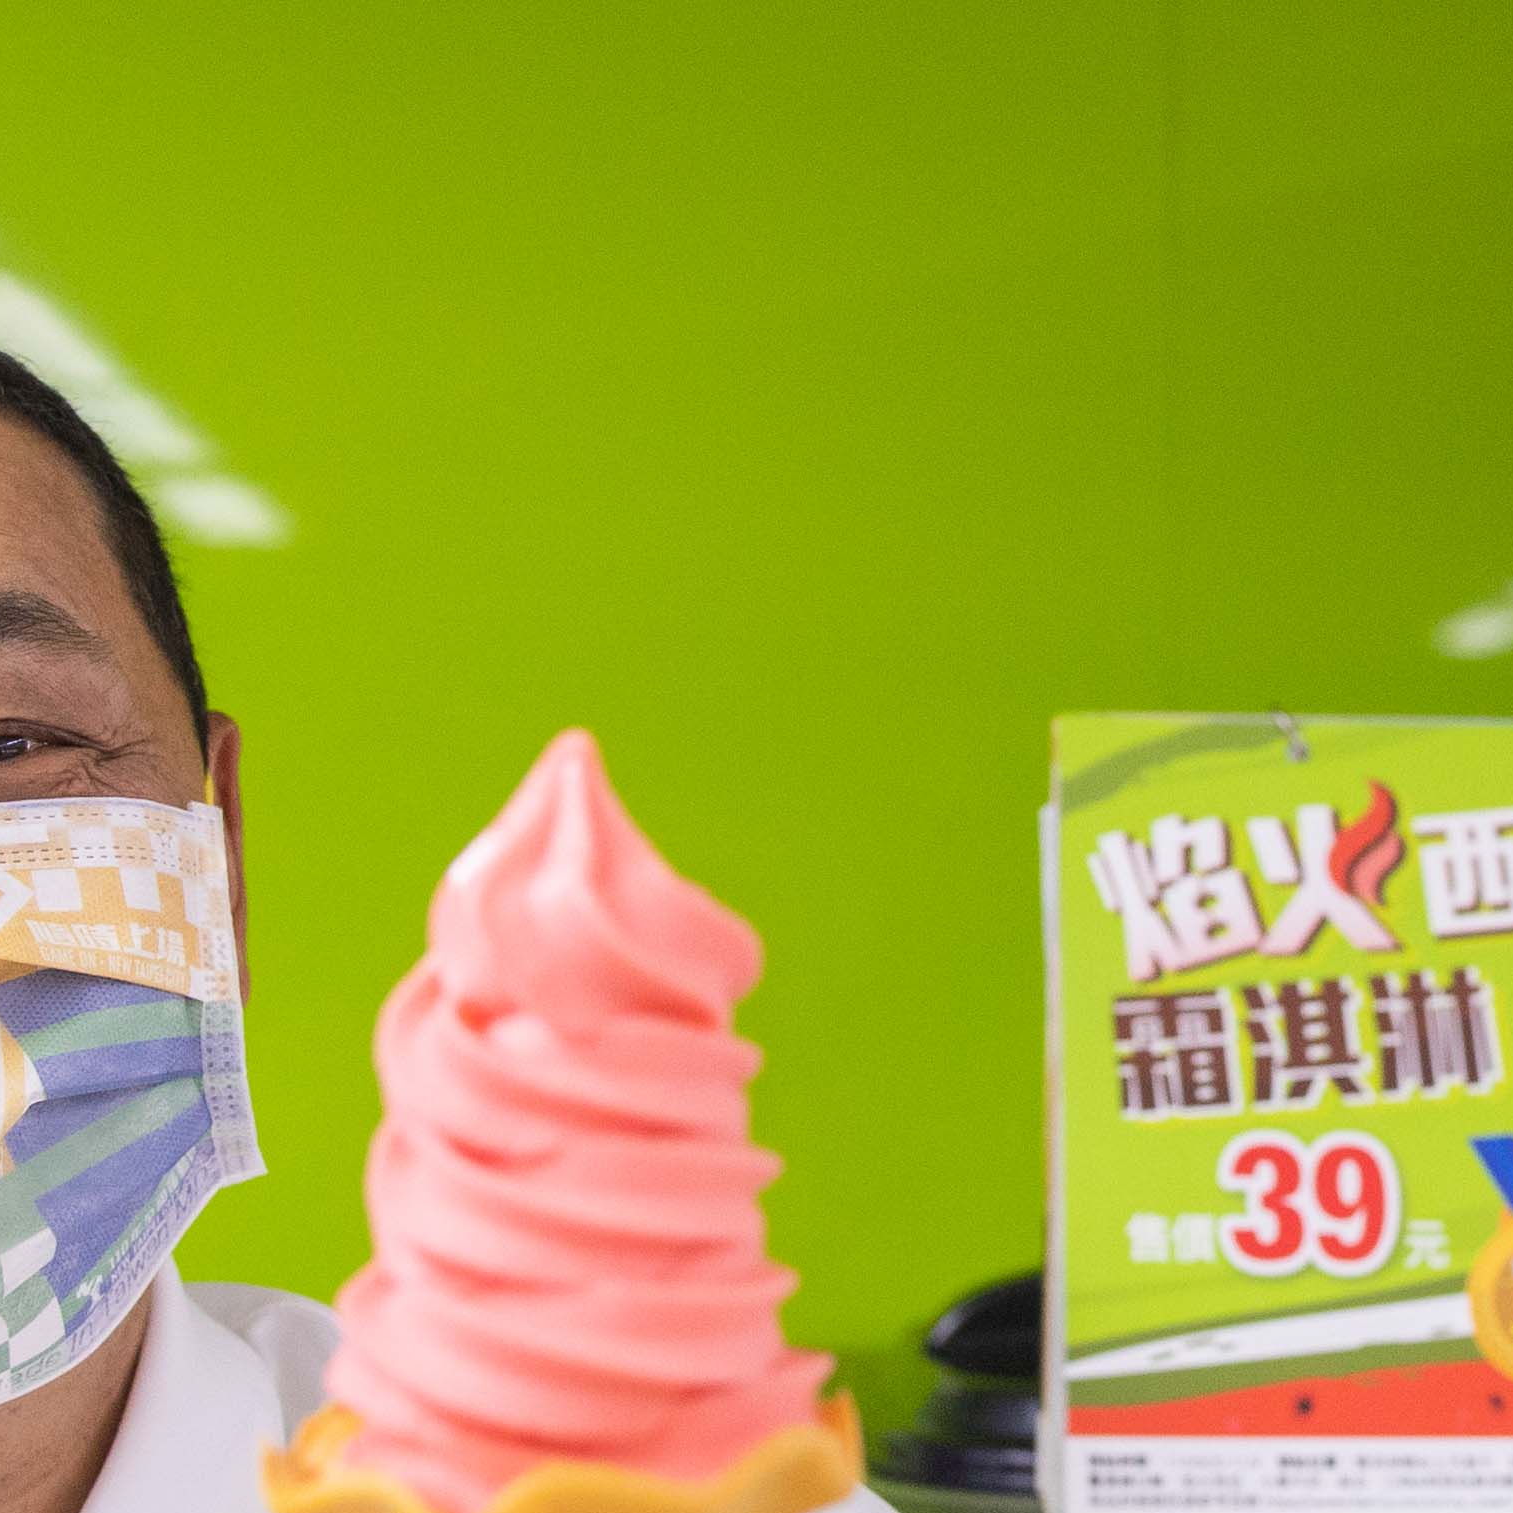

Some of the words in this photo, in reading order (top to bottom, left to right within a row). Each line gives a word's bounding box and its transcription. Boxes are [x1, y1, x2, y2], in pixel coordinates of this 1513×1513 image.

[1111, 967, 1505, 1121] 霜淇淋
[1223, 1134, 1397, 1271] 39
